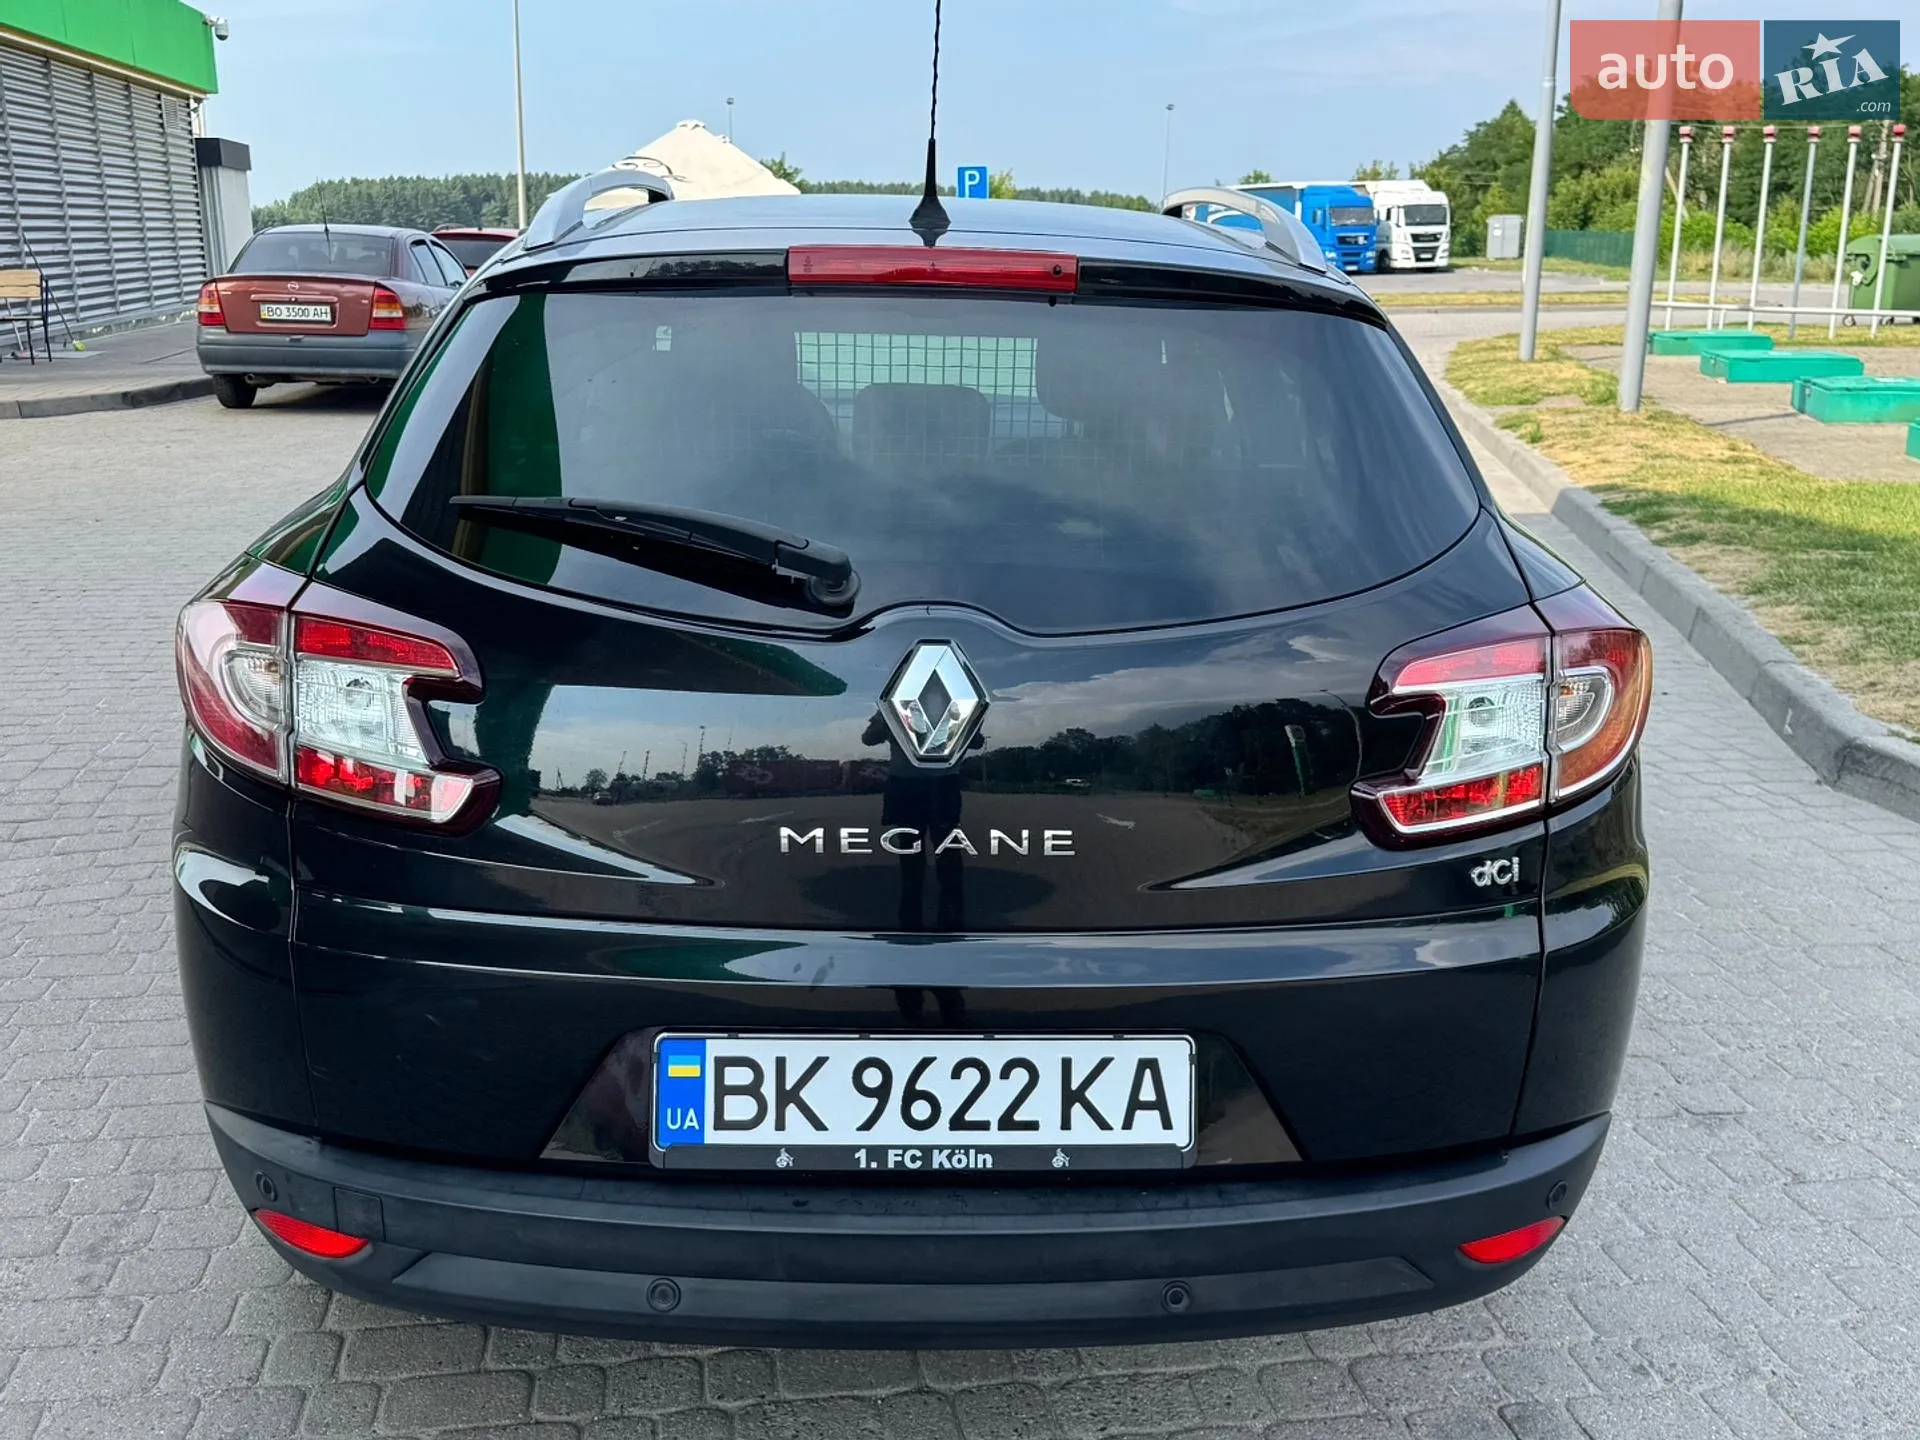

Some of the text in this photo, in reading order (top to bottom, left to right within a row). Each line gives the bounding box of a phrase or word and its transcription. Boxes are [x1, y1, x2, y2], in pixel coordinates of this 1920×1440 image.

[964, 170, 980, 198] P
[266, 306, 328, 319] BO 3500 AH
[779, 826, 1076, 856] MEGANE
[713, 1055, 1174, 1132] BK 9622 KA
[666, 1107, 700, 1131] UA
[854, 1148, 994, 1169] 1. FC Köln
